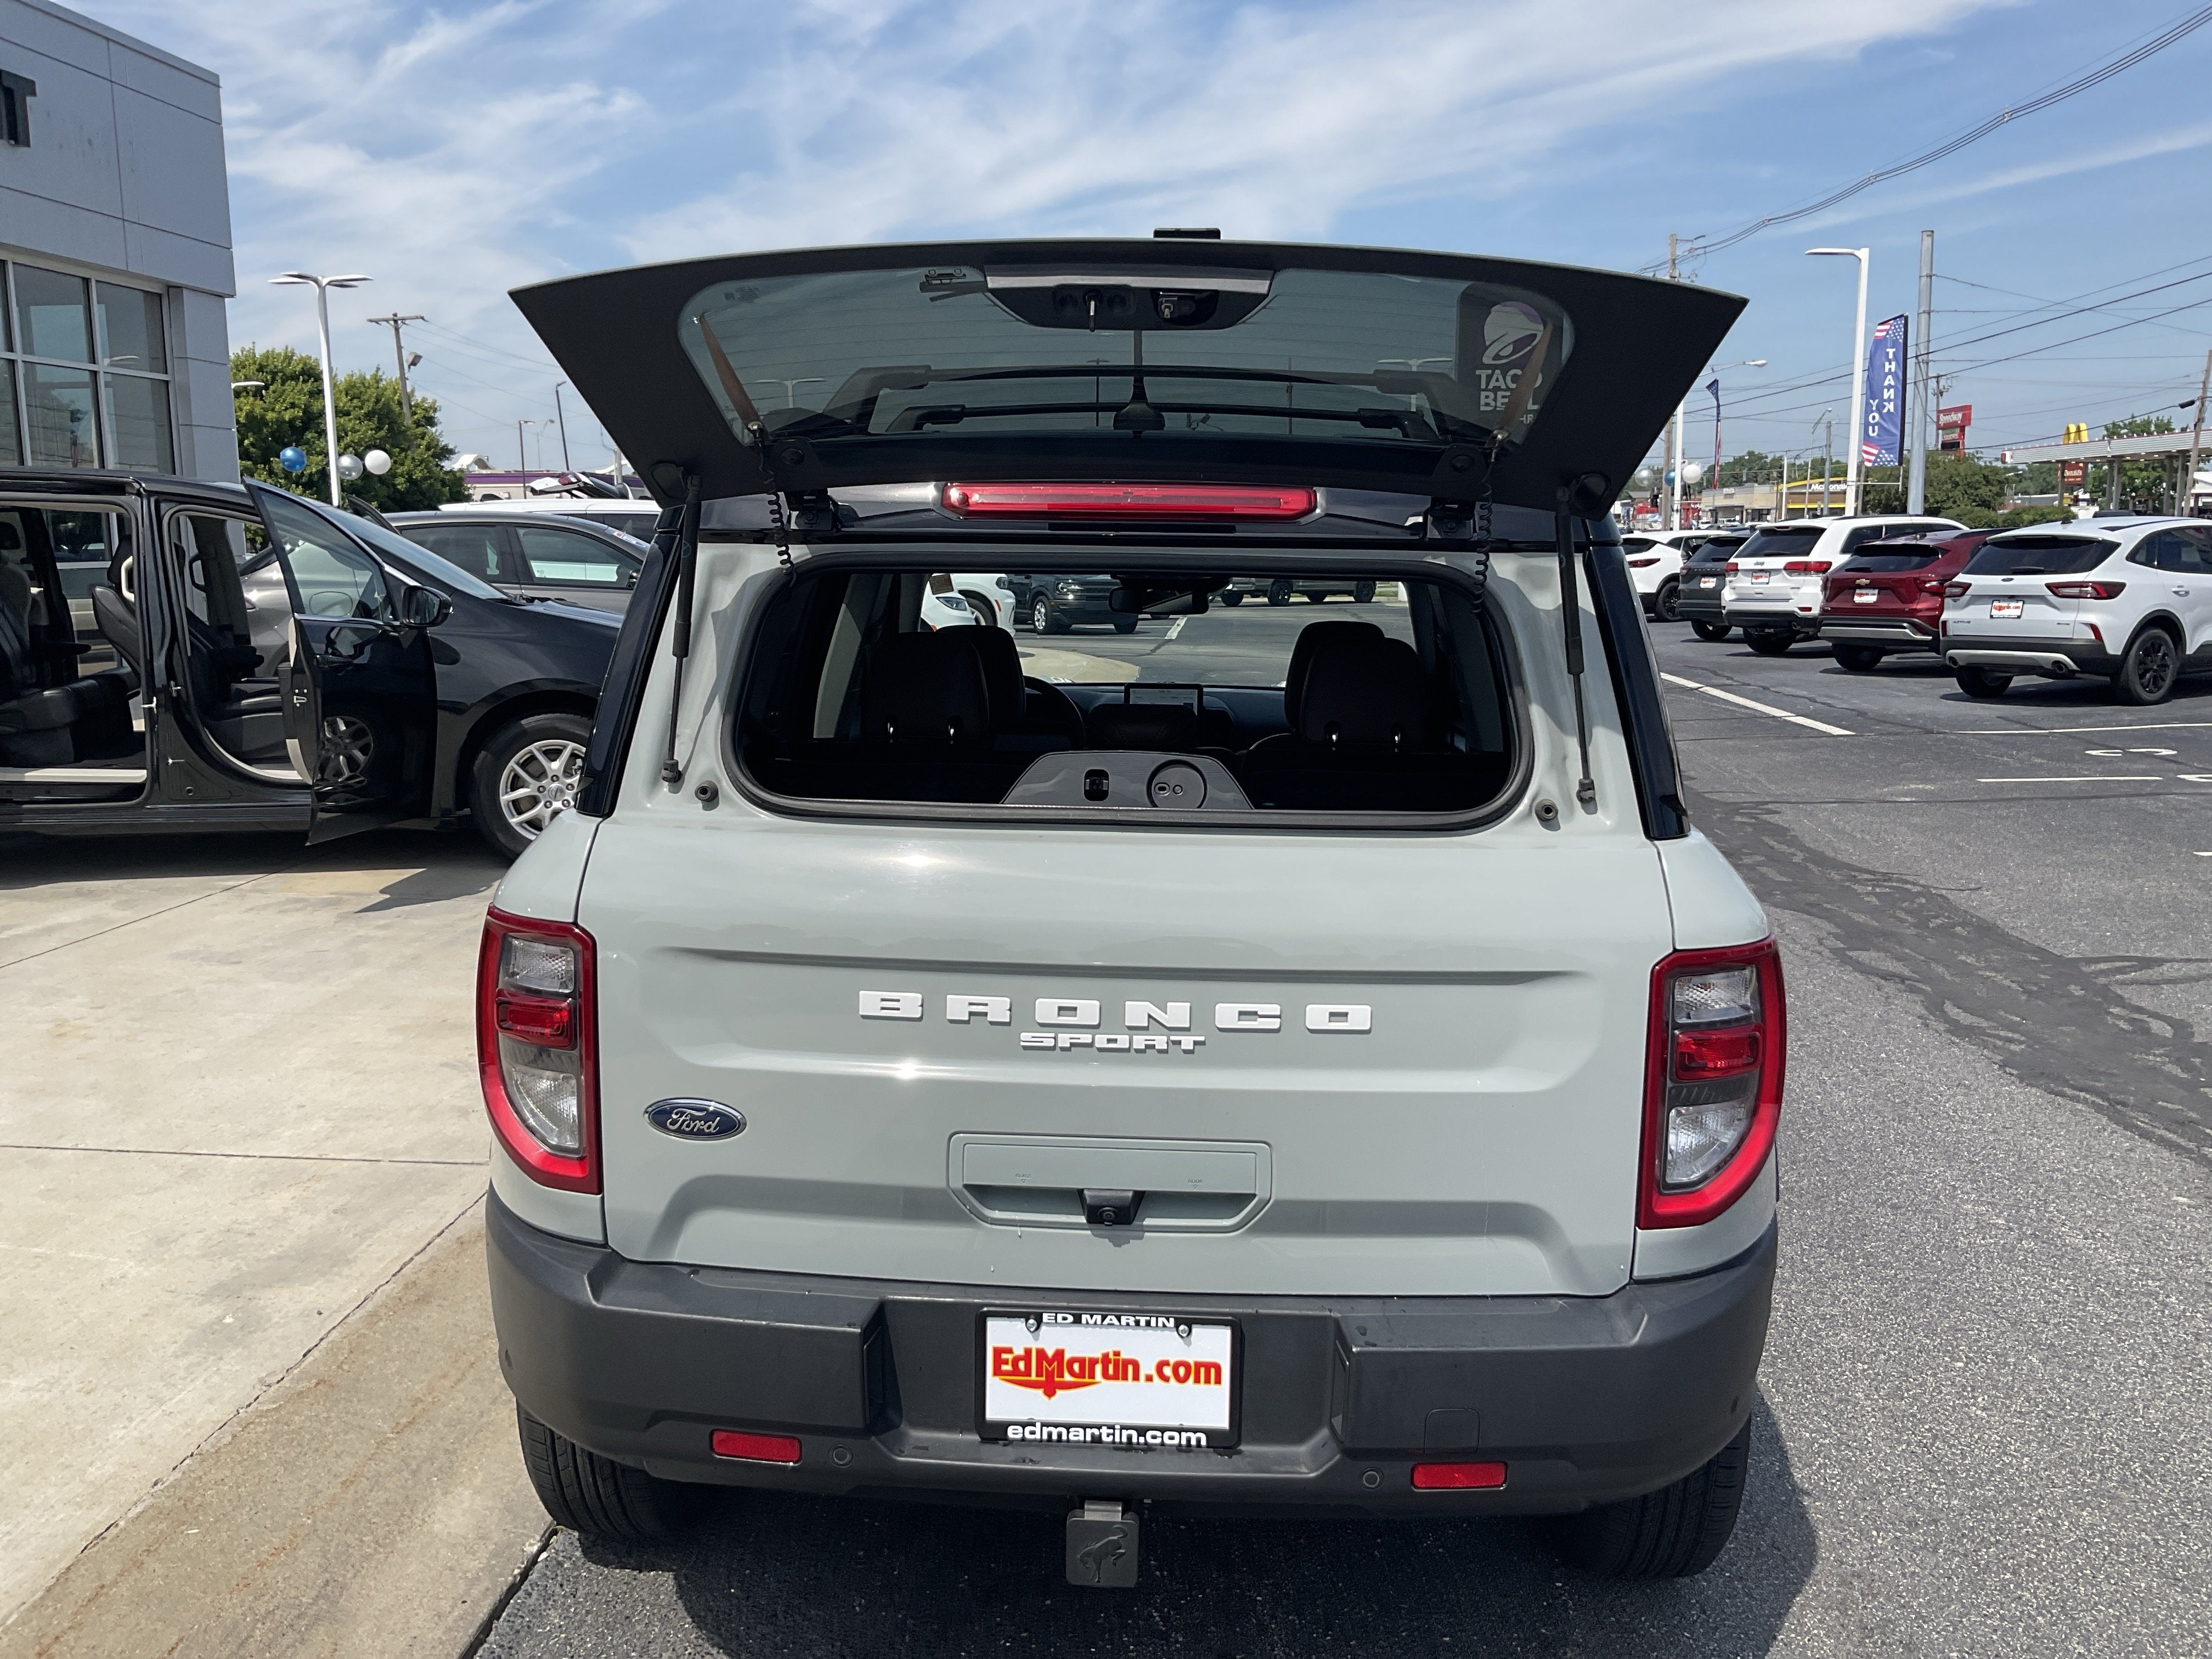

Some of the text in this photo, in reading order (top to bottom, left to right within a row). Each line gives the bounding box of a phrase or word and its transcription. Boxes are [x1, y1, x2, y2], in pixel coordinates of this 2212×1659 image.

[1475, 369, 1543, 389] TAC
[1480, 391, 1541, 410] BEL
[859, 990, 1373, 1033] BRONCO
[1019, 1031, 1205, 1054] SPORT
[666, 1108, 721, 1133] Ford
[1042, 1313, 1175, 1328] ED MARTIN
[991, 1345, 1223, 1387] EdMartin.com
[1007, 1422, 1207, 1446] edmartin.com
